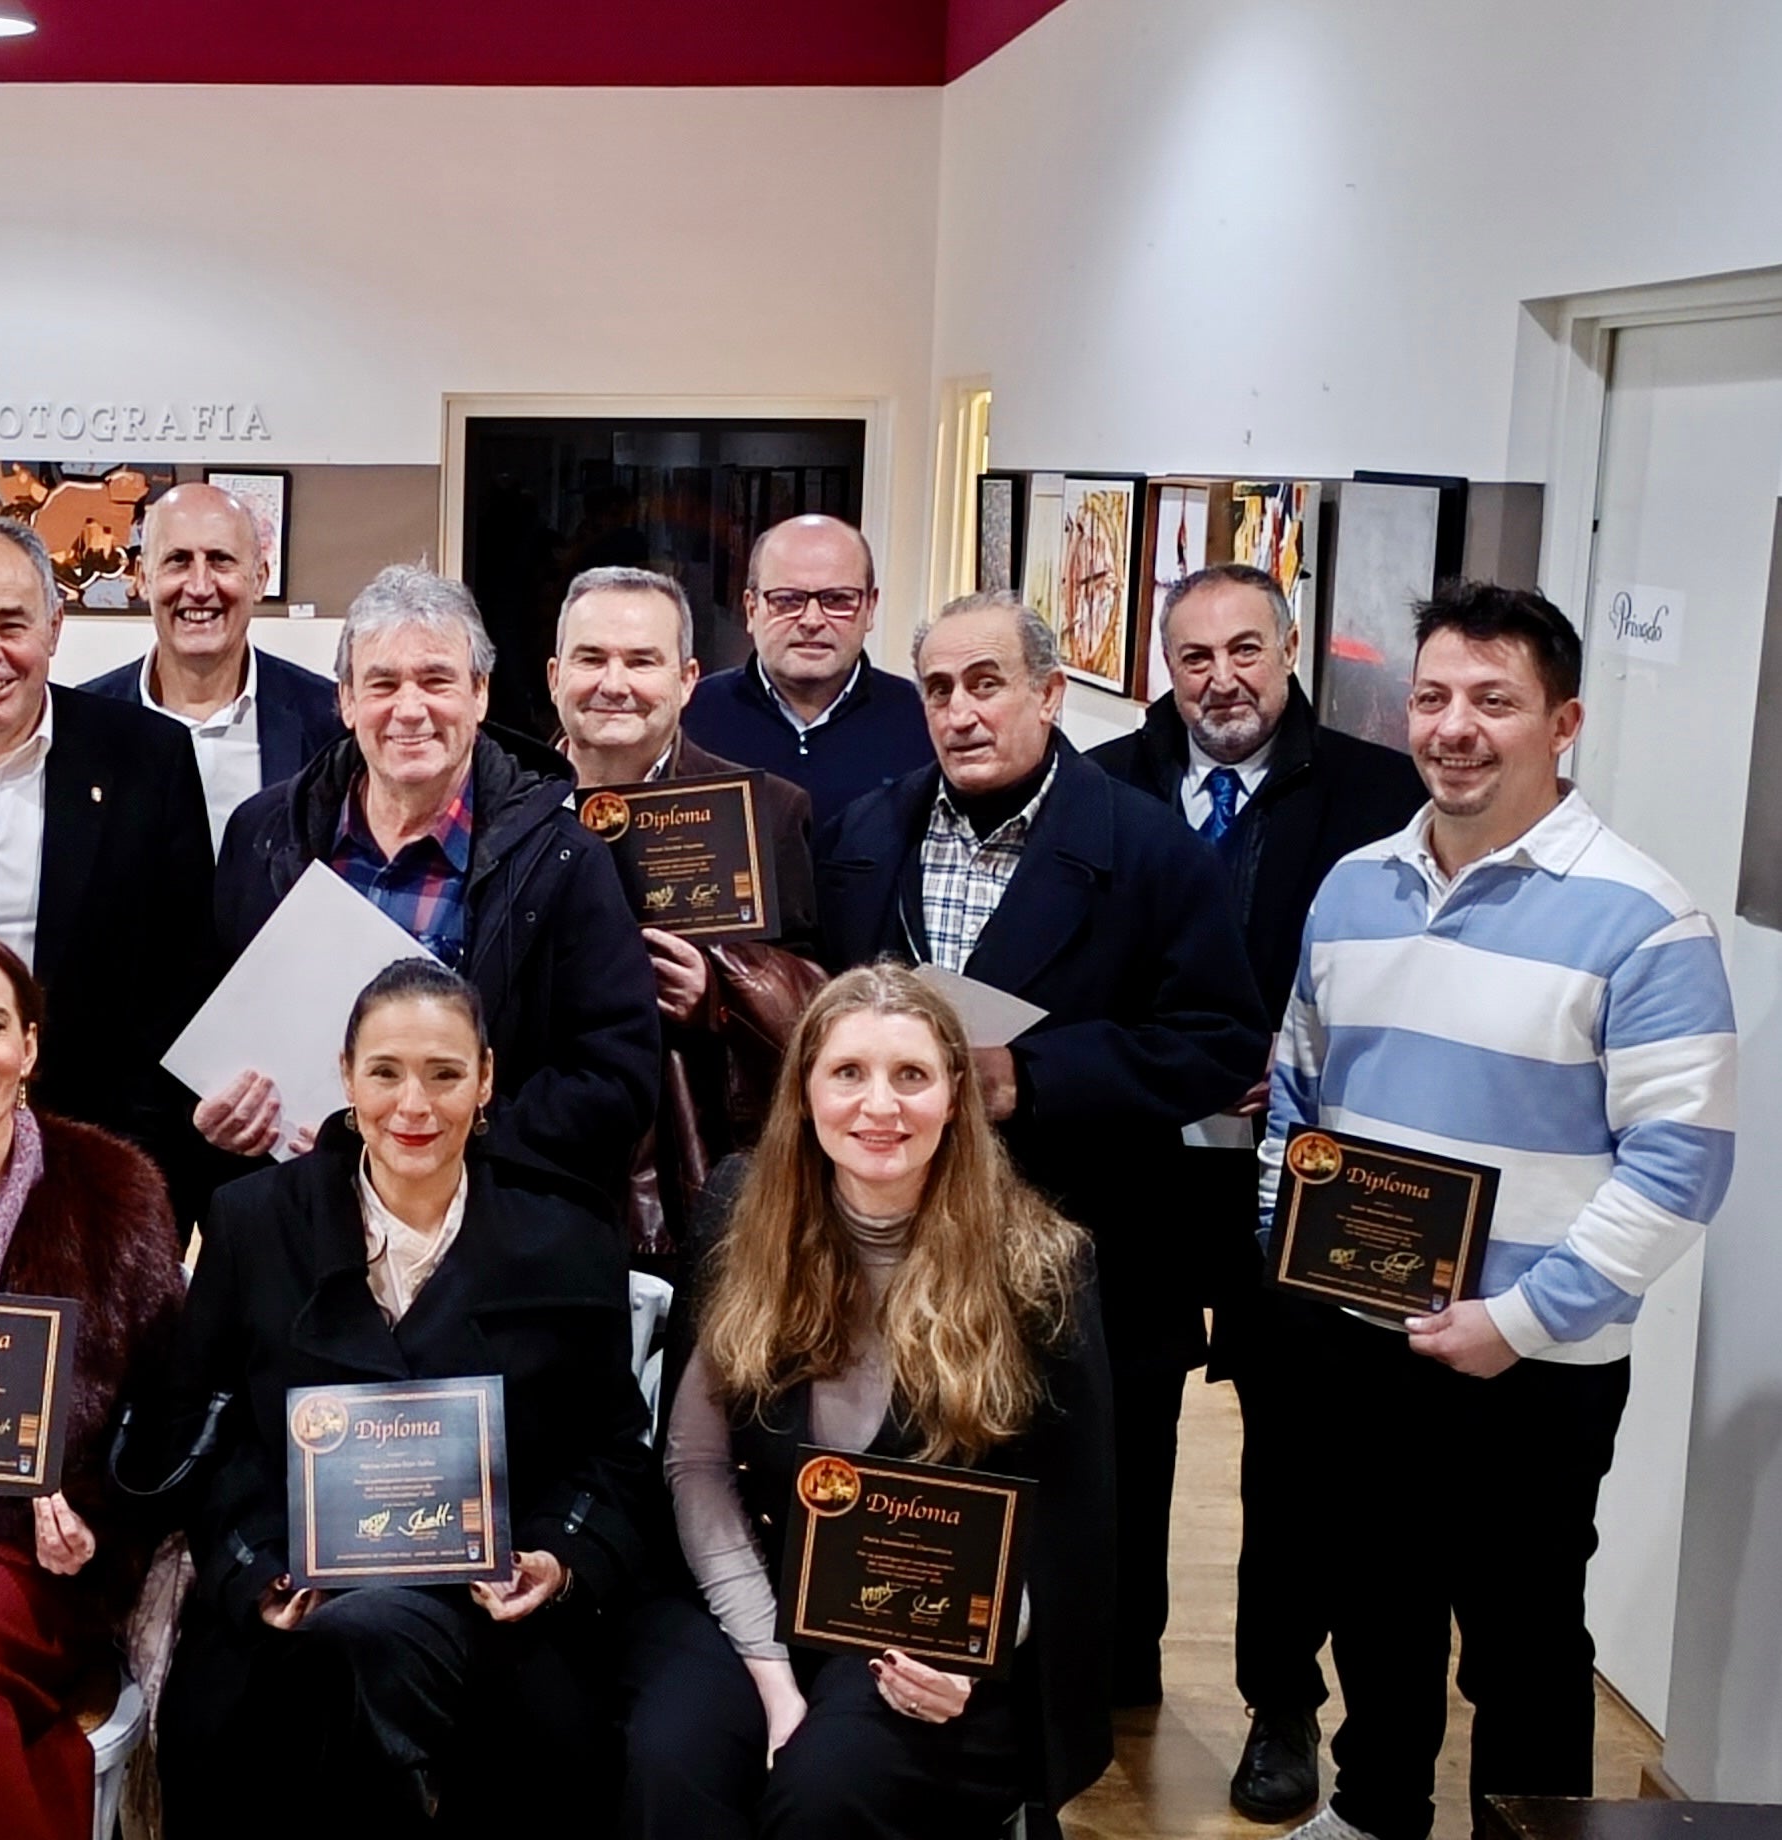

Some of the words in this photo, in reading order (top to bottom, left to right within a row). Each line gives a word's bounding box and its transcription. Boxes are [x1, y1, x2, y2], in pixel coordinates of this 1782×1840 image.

[635, 804, 712, 835] Diploma
[1346, 1167, 1431, 1200] Diploma
[354, 1413, 441, 1449] Diploma
[866, 1493, 961, 1525] Diploma
